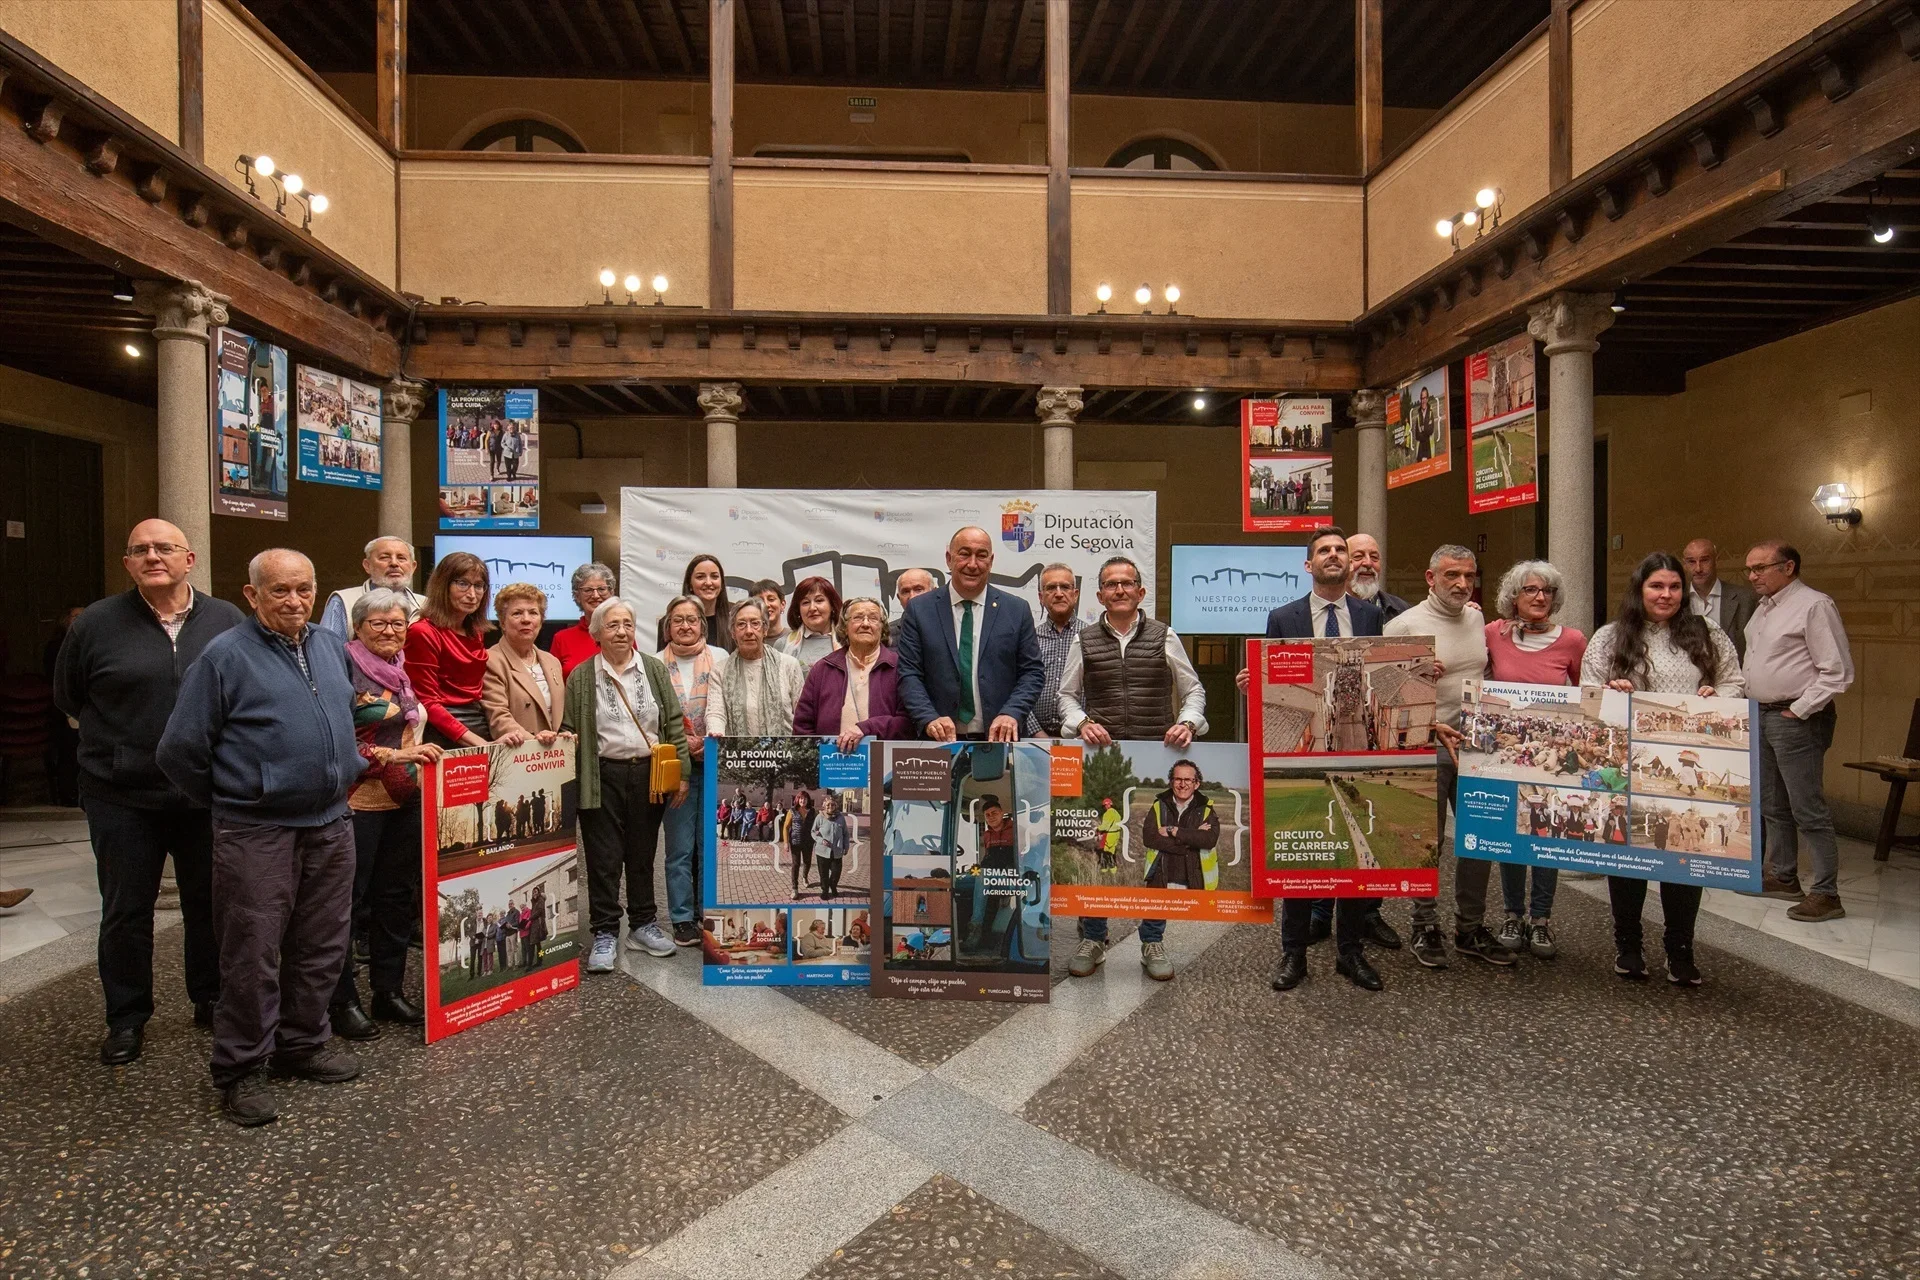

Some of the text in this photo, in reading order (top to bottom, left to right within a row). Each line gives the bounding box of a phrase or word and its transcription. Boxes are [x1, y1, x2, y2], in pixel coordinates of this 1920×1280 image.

[1476, 468, 1494, 476] CIRCUITO
[1482, 472, 1503, 482] CARRERAS
[1476, 480, 1498, 490] PEDESTRES
[1044, 514, 1134, 532] Diputación
[1044, 534, 1134, 553] de Segovia
[1483, 687, 1522, 696] CARNAVAL
[513, 749, 565, 764] AULAS PARA
[740, 750, 792, 758] PROVINCIA
[526, 760, 565, 773] CONVIVIR
[726, 761, 745, 770] QUE
[1056, 809, 1098, 817] ROGELIO
[1055, 818, 1091, 827] MUÑOZ
[1274, 831, 1324, 840] CIRCUITO
[1274, 841, 1349, 850] DE CARRERAS
[1480, 839, 1512, 848] Diputación
[486, 843, 514, 854] BAILANDO
[1576, 849, 1600, 857] Carnaval
[1274, 853, 1335, 861] PEDESTRES
[545, 941, 572, 955] CANTANDO
[928, 978, 939, 986] elijo
[908, 986, 919, 994] elijo
